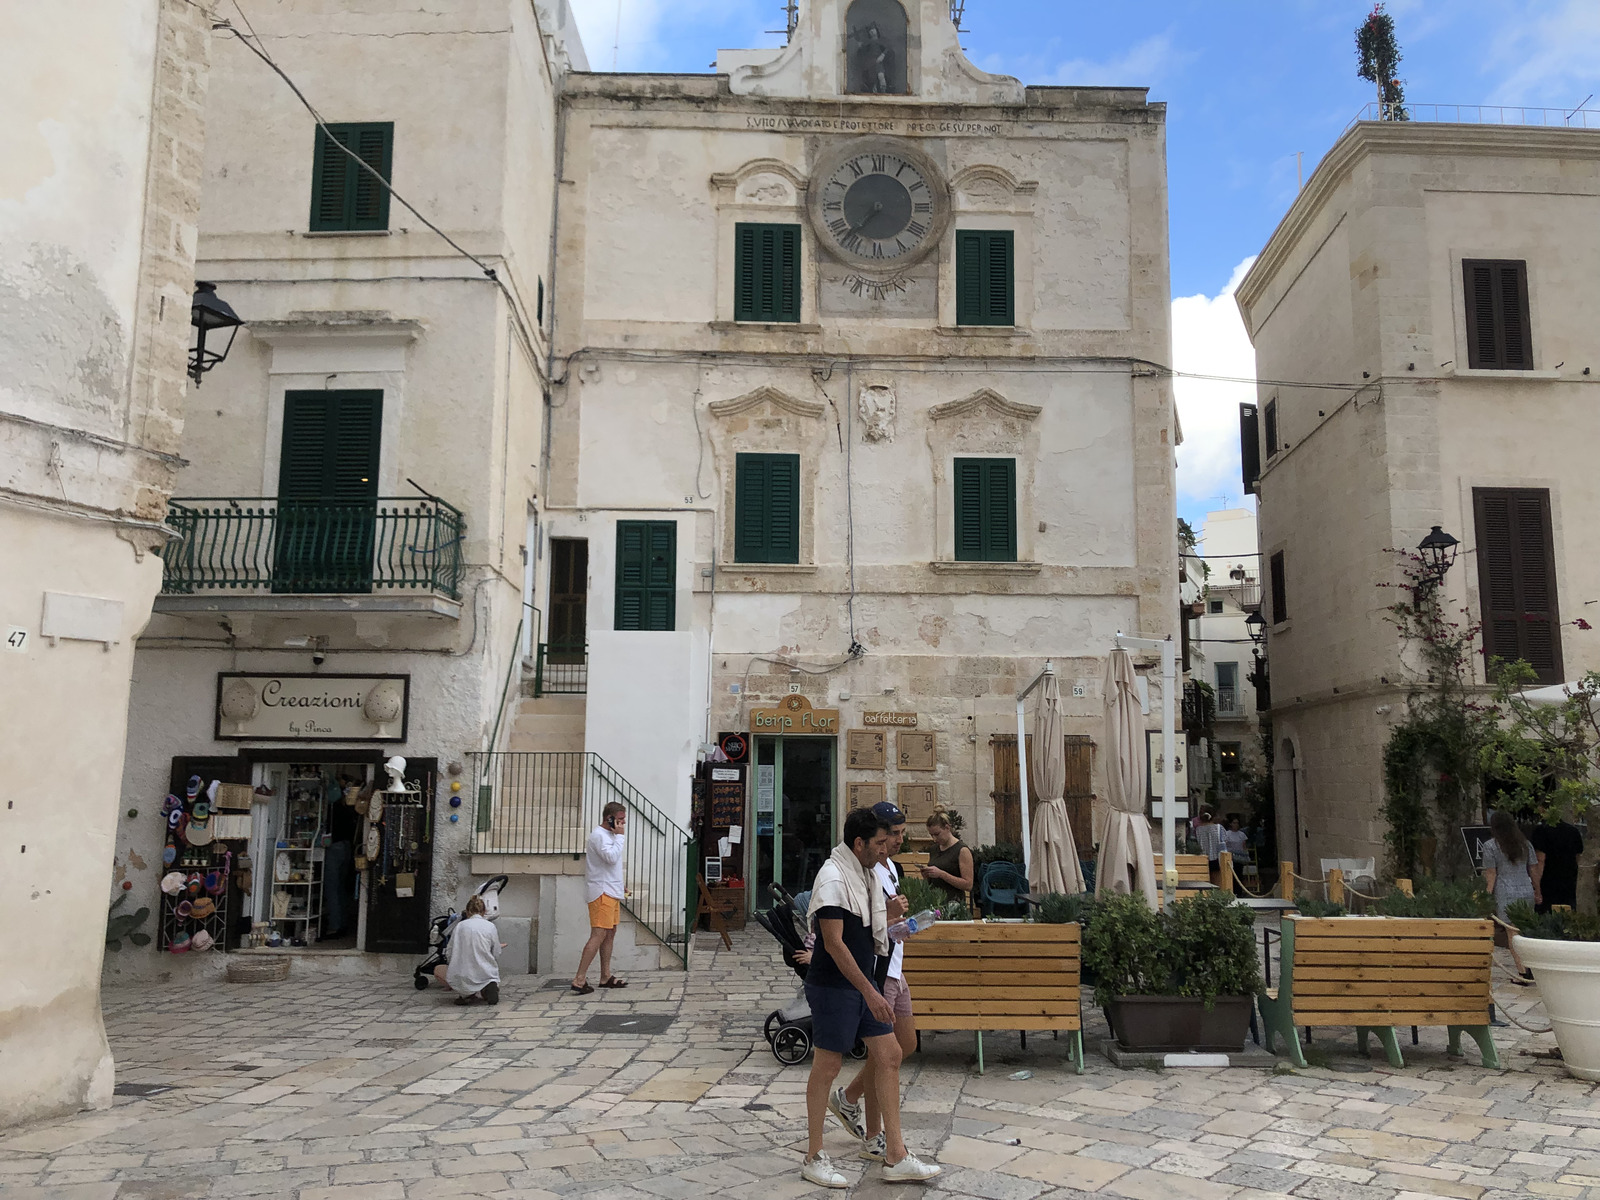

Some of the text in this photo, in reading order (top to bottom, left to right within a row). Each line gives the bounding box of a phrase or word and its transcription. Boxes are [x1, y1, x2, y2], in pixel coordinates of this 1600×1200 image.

[914, 203, 930, 213] III
[684, 496, 693, 504] 53
[8, 631, 26, 647] 47
[261, 679, 363, 708] Creazioni
[790, 685, 799, 693] 57
[864, 712, 917, 724] caffetteria
[289, 721, 300, 736] by
